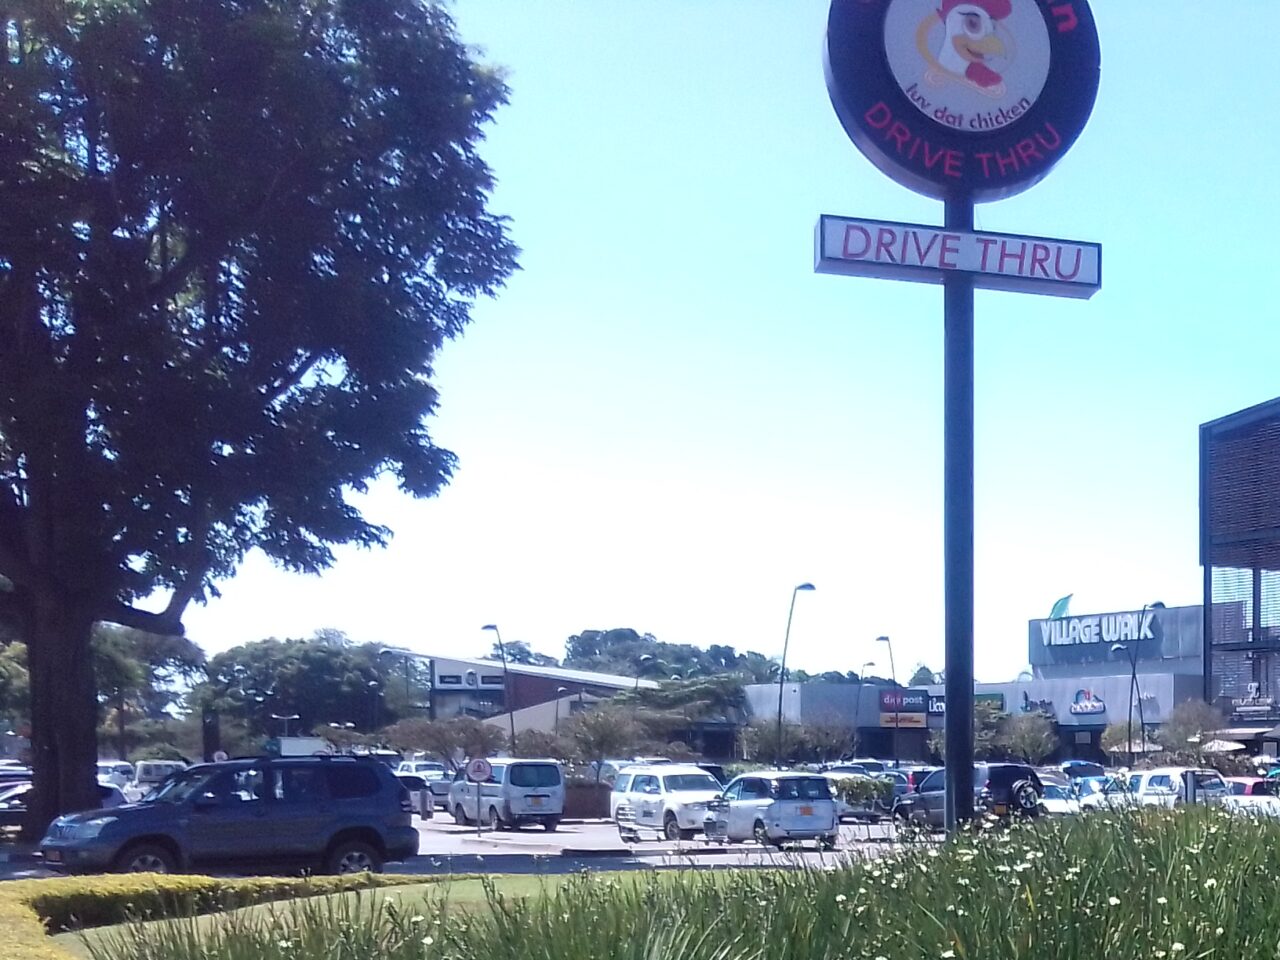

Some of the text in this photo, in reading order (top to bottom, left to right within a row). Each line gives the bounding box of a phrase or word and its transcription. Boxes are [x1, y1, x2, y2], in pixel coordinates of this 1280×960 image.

[905, 83, 1031, 129] luv dat chicken
[864, 101, 1062, 178] DRIVE THRU
[842, 224, 1082, 280] DRIVE THRU
[1040, 613, 1154, 646] VILLAGE WALK
[902, 695, 924, 707] post
